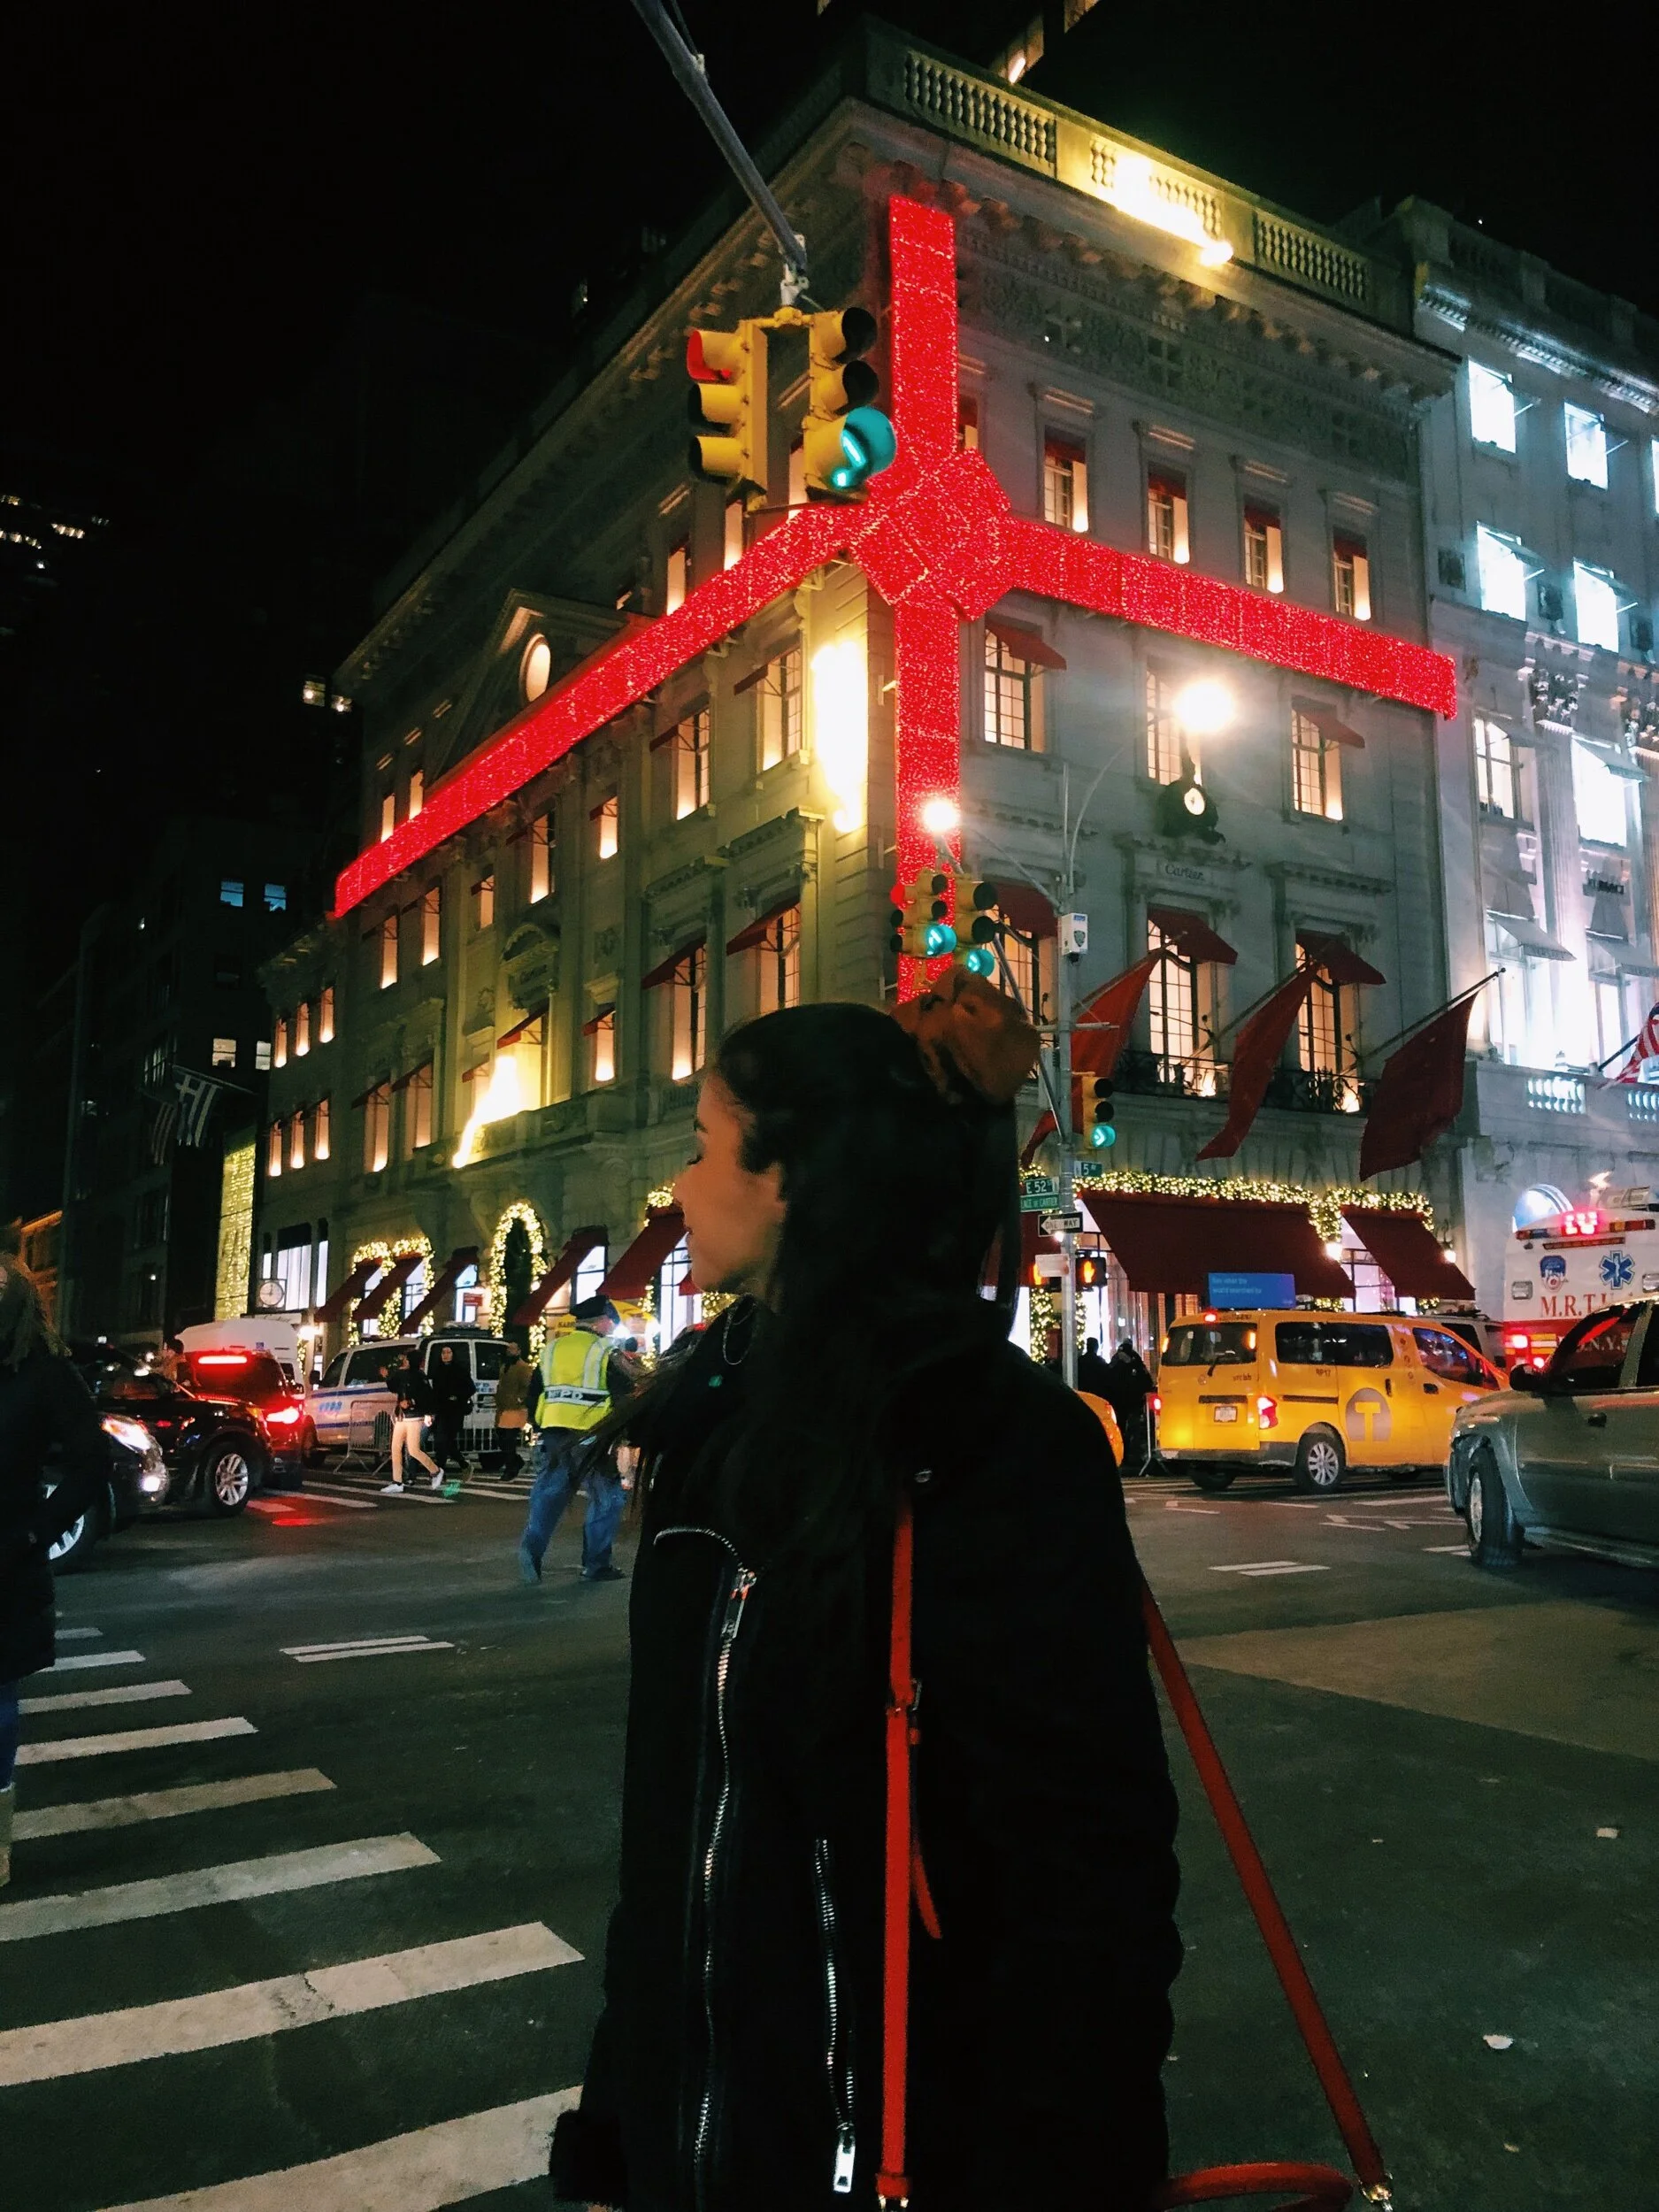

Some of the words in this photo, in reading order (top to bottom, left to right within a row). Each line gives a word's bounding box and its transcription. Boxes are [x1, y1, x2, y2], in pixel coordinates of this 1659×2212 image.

[1083, 1164, 1090, 1175] 5
[1026, 1182, 1033, 1194] E
[1034, 1181, 1047, 1193] 52
